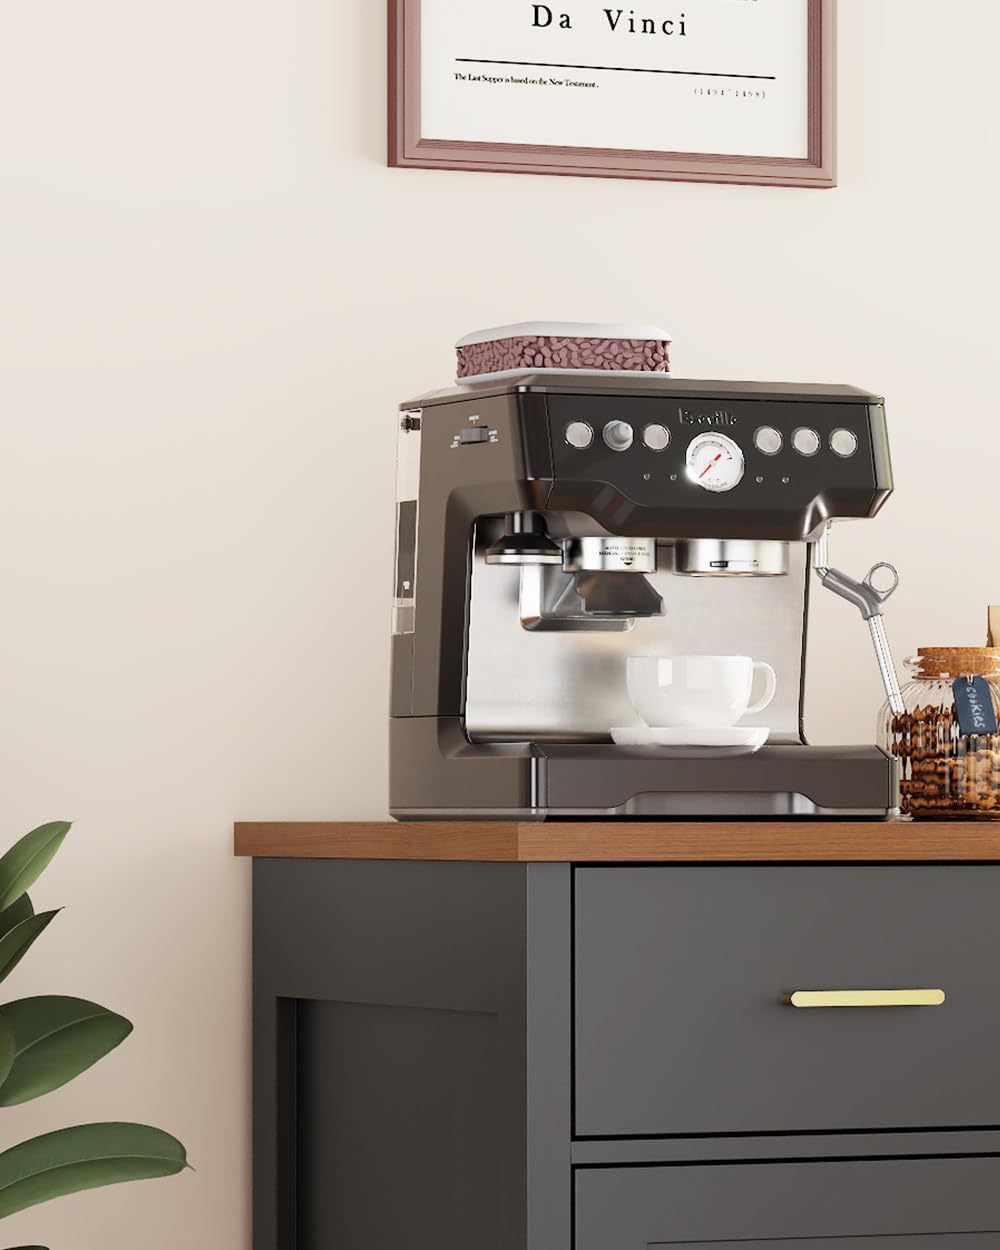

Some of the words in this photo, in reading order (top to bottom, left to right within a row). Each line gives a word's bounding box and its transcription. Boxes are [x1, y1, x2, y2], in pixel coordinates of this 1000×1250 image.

[532, 4, 572, 29] Da
[603, 9, 686, 35] Vinci
[454, 73, 467, 81] The
[468, 73, 481, 81] Last
[549, 78, 563, 86] New
